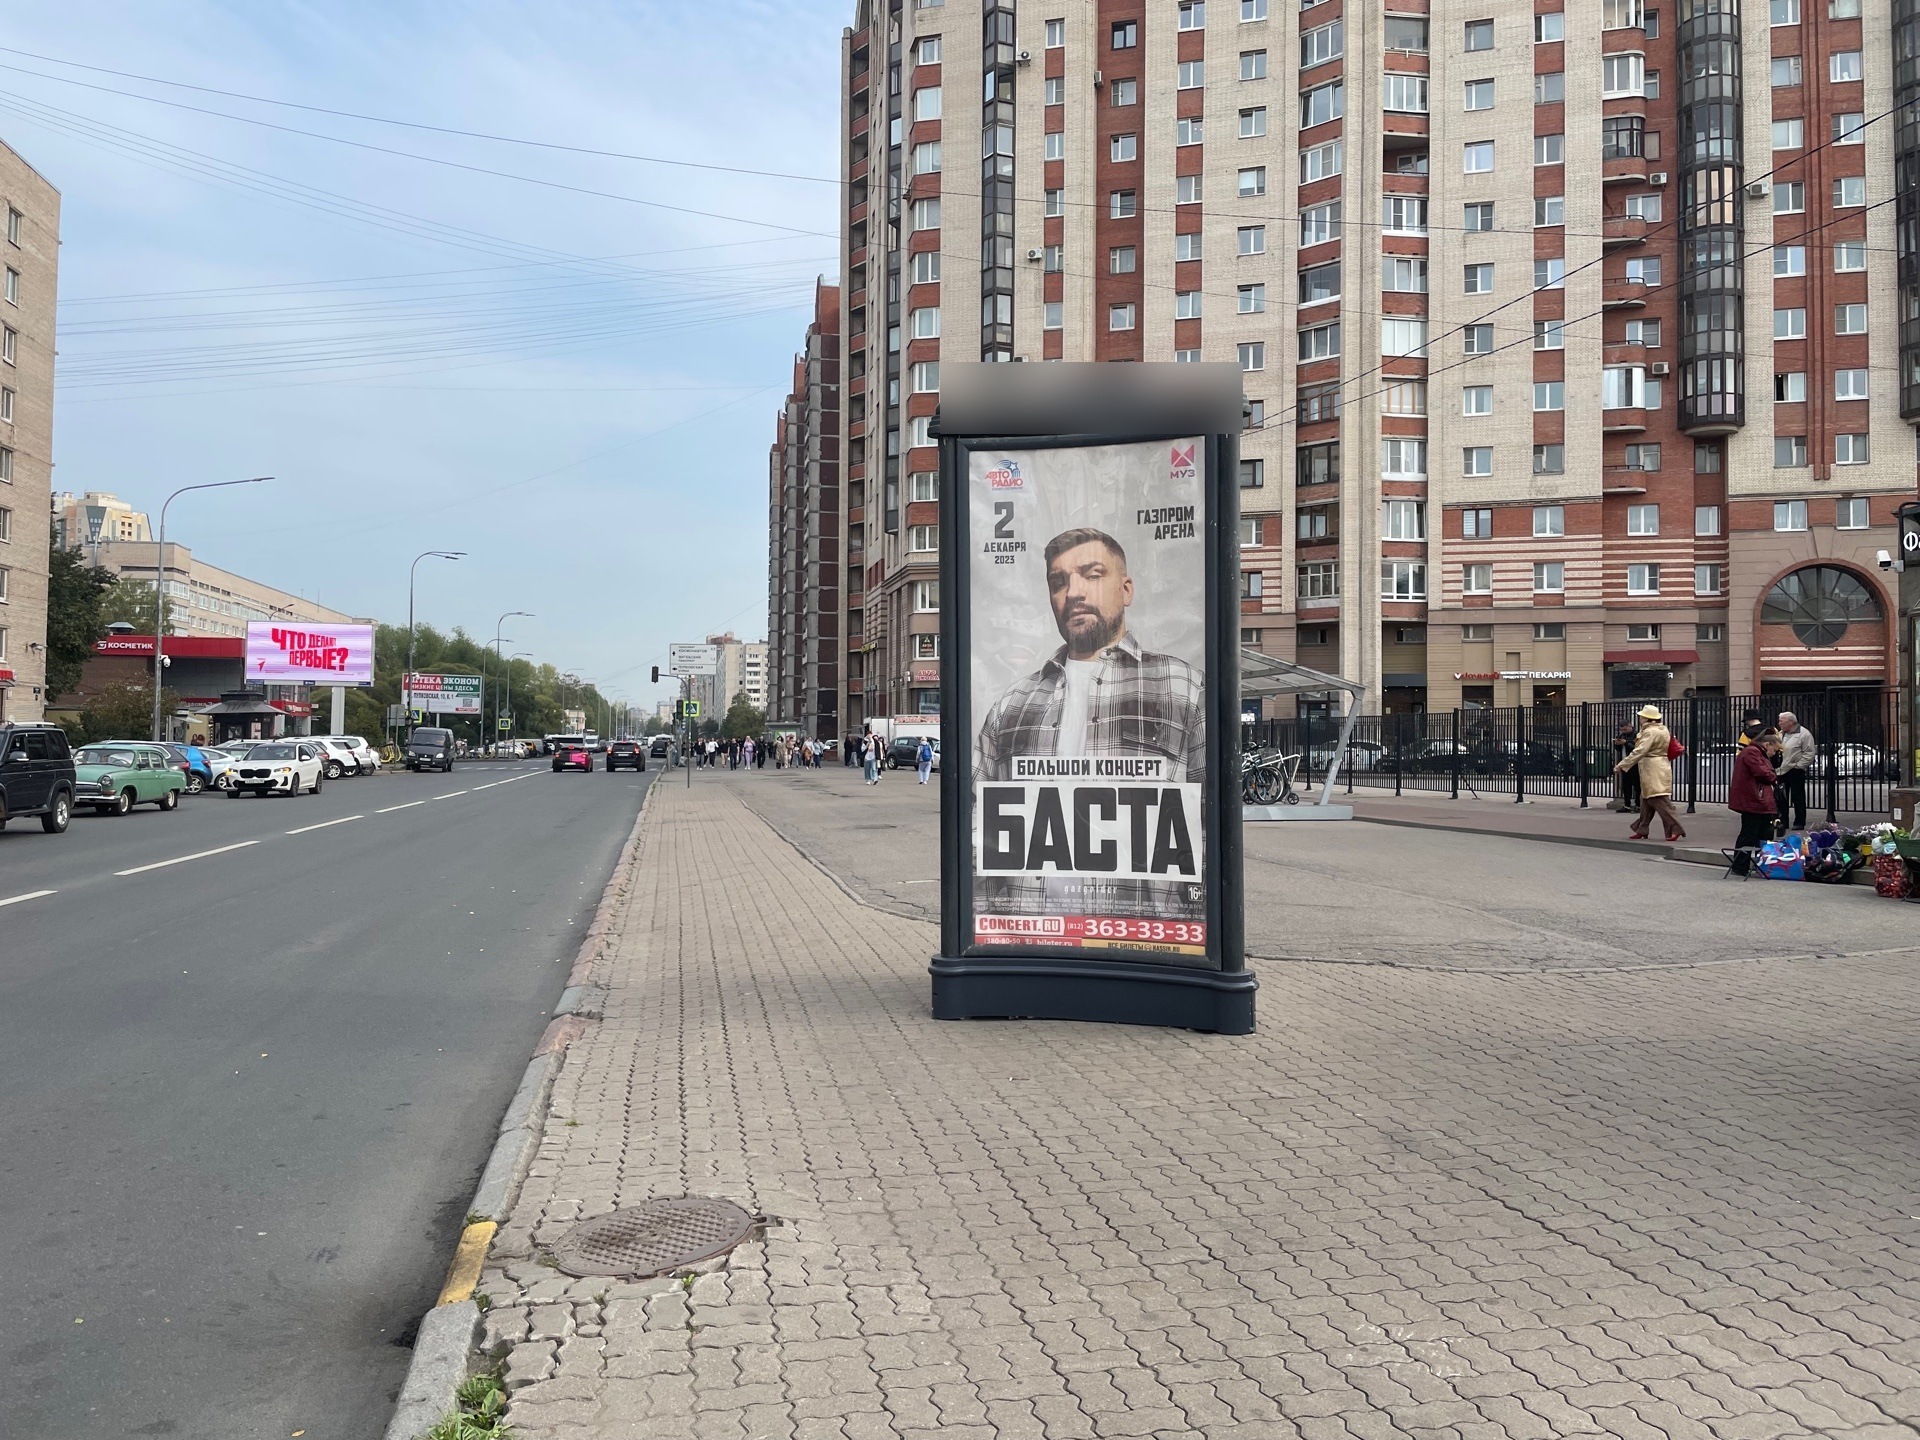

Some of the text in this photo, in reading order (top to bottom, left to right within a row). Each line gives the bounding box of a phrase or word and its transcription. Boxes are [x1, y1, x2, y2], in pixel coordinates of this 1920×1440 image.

[985, 470, 1010, 480] АВТО
[1170, 469, 1195, 479] МУЗ
[992, 478, 1024, 488] РАДИО
[994, 501, 1015, 539] 2
[1137, 505, 1195, 526] ГАЗПРОМ
[1154, 522, 1195, 540] АРЕНА
[983, 541, 1027, 553] ДЕКАБРЯ
[994, 555, 1015, 565] 2023
[107, 642, 153, 650] КОСМЕТИК
[271, 628, 307, 650] ЧТО
[289, 647, 349, 672] ПЕРВЫЕ?
[443, 677, 479, 685] ЭКОНОМ
[1529, 671, 1572, 679] ПЕКАРНЯ
[1017, 757, 1162, 779] БОЛЬШОЙ КОНЦЕРТ
[982, 786, 1196, 876] БАСТА
[1188, 886, 1203, 901] 16+
[1067, 919, 1204, 943] (812) 363-33-33
